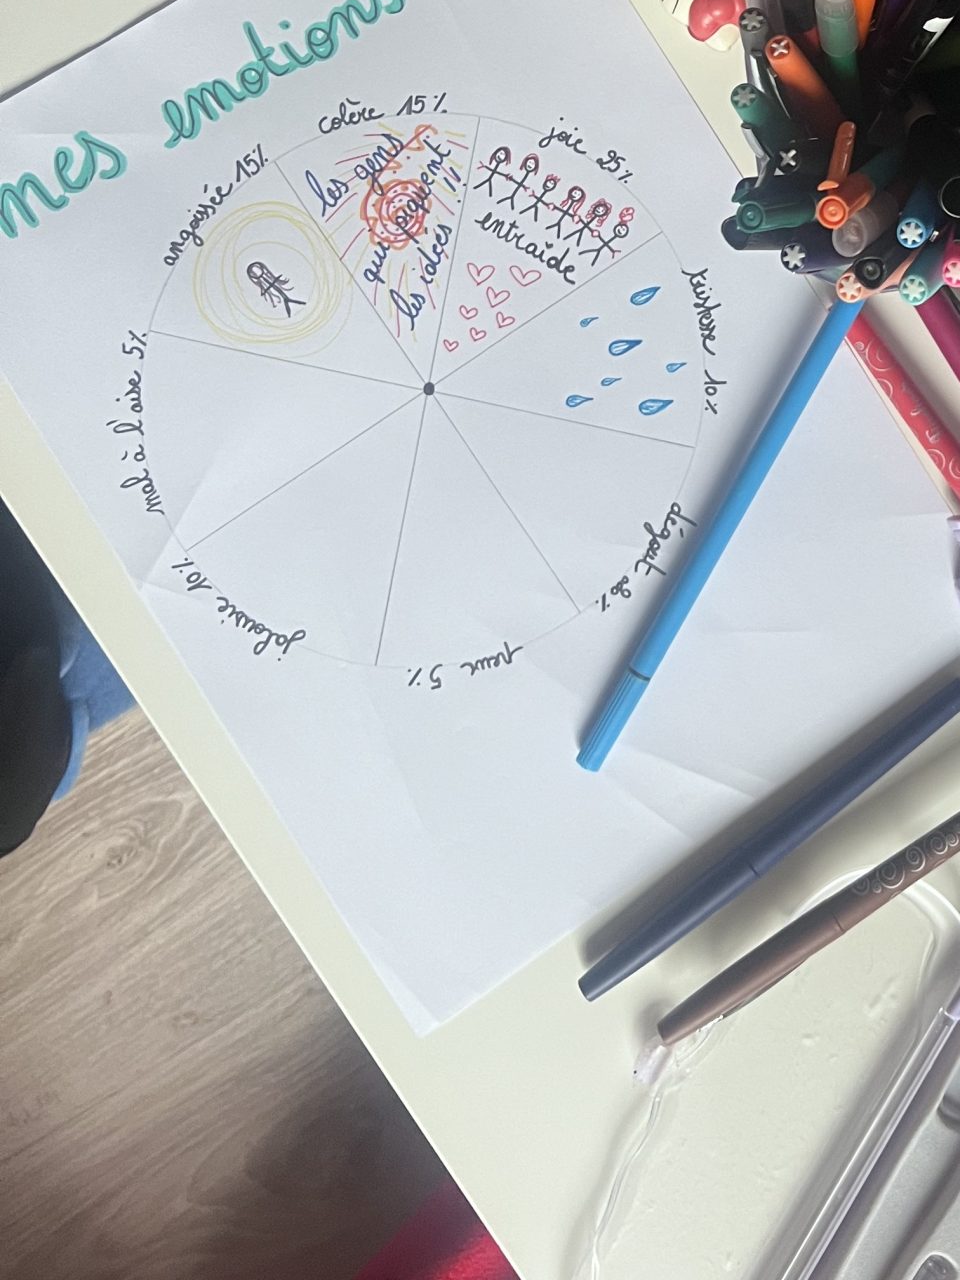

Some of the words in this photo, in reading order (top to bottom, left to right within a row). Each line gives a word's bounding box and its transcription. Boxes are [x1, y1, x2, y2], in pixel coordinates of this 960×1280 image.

[318, 97, 385, 134] colère
[397, 92, 448, 116] 15%
[235, 143, 270, 183] 15%
[538, 116, 587, 156] joie
[595, 149, 635, 184] 25%
[0, 131, 128, 239] mes
[305, 170, 350, 218] les
[353, 133, 405, 197] gens
[363, 228, 391, 286] qui
[394, 135, 452, 245] piquent
[388, 288, 427, 332] les
[121, 328, 148, 360] 5%
[680, 267, 723, 357] tristesse
[704, 369, 728, 416] 10%
[120, 443, 146, 463] à
[120, 468, 165, 516] mal
[170, 557, 213, 593] 10%
[216, 595, 307, 662] jalousie
[459, 641, 524, 678] peur
